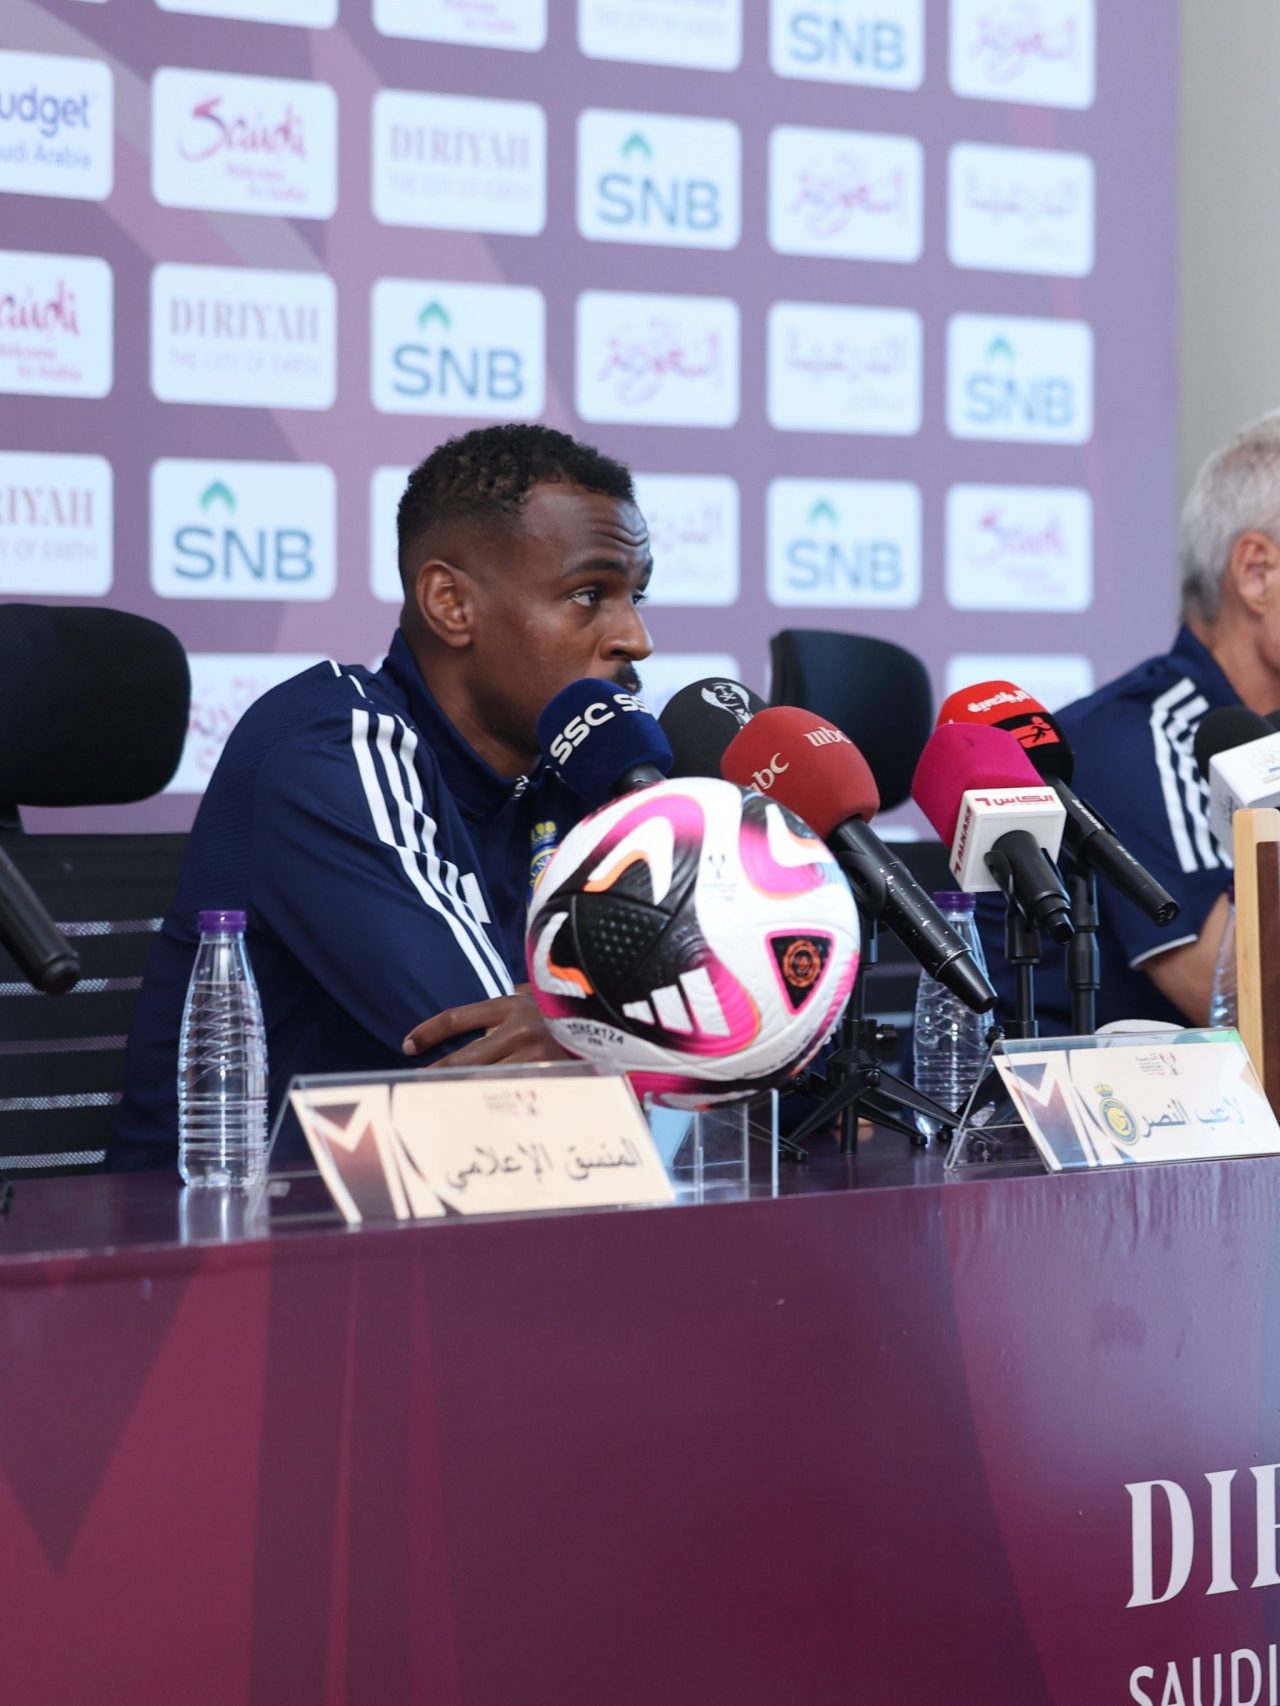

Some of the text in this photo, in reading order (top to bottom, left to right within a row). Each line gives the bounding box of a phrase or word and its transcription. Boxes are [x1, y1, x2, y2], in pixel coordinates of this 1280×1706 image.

[788, 10, 906, 74] SNB
[0, 86, 91, 138] udget
[597, 171, 722, 231] SNB
[0, 279, 80, 337] audi
[391, 343, 524, 402] SNB
[963, 371, 1076, 428] SNB
[172, 525, 315, 582] SNB
[786, 537, 903, 592] SNB
[613, 693, 652, 714] SS
[549, 702, 615, 766] SSC
[1141, 1096, 1246, 1138] لاعب النصر
[565, 1136, 643, 1180] المنسق
[1129, 1643, 1278, 1706] SAUDI
